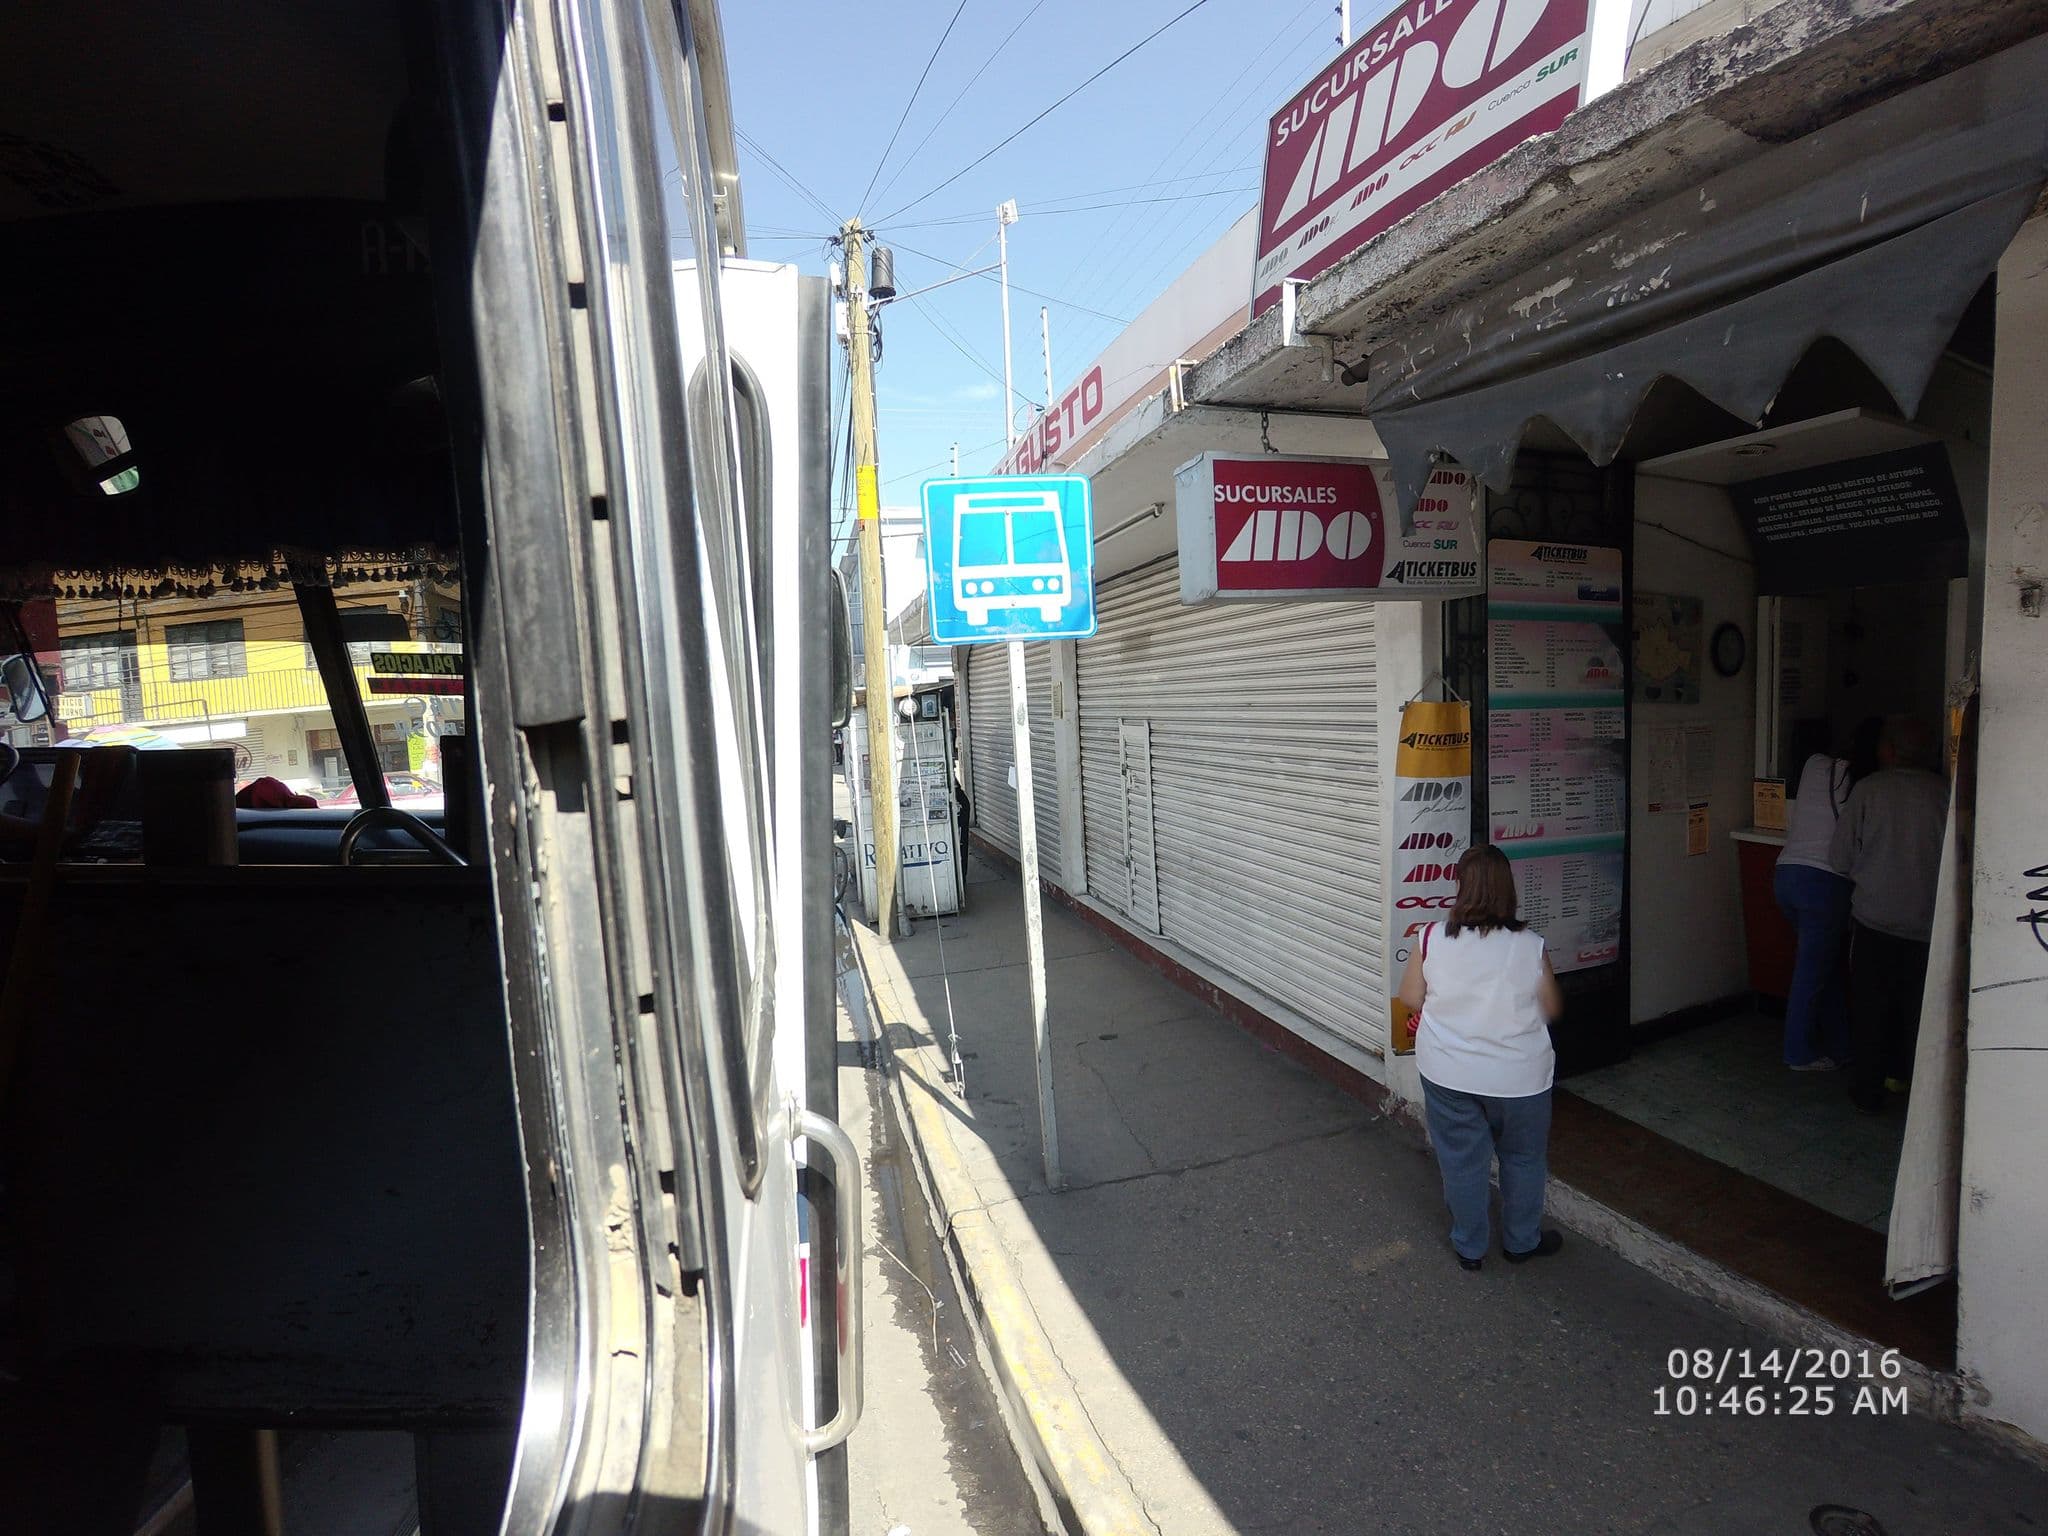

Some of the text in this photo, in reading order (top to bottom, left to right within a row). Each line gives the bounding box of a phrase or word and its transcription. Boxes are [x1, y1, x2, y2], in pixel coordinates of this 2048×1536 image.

[1272, 0, 1551, 233] ADO
[1349, 172, 1389, 212] ADO
[1487, 80, 1532, 111] Cuenca
[1534, 47, 1579, 84] SUR
[1015, 364, 1104, 474] GUSTO
[1429, 471, 1467, 486] ADO
[1876, 474, 1887, 482] DE
[1213, 484, 1337, 504] SUCURSALES
[1220, 510, 1373, 562] ADO
[1433, 539, 1458, 549] SUR
[1406, 561, 1477, 577] TICKETBUS
[1417, 731, 1470, 746] TICKETBUS
[1399, 781, 1463, 802] ADO
[1398, 832, 1453, 850] ADO
